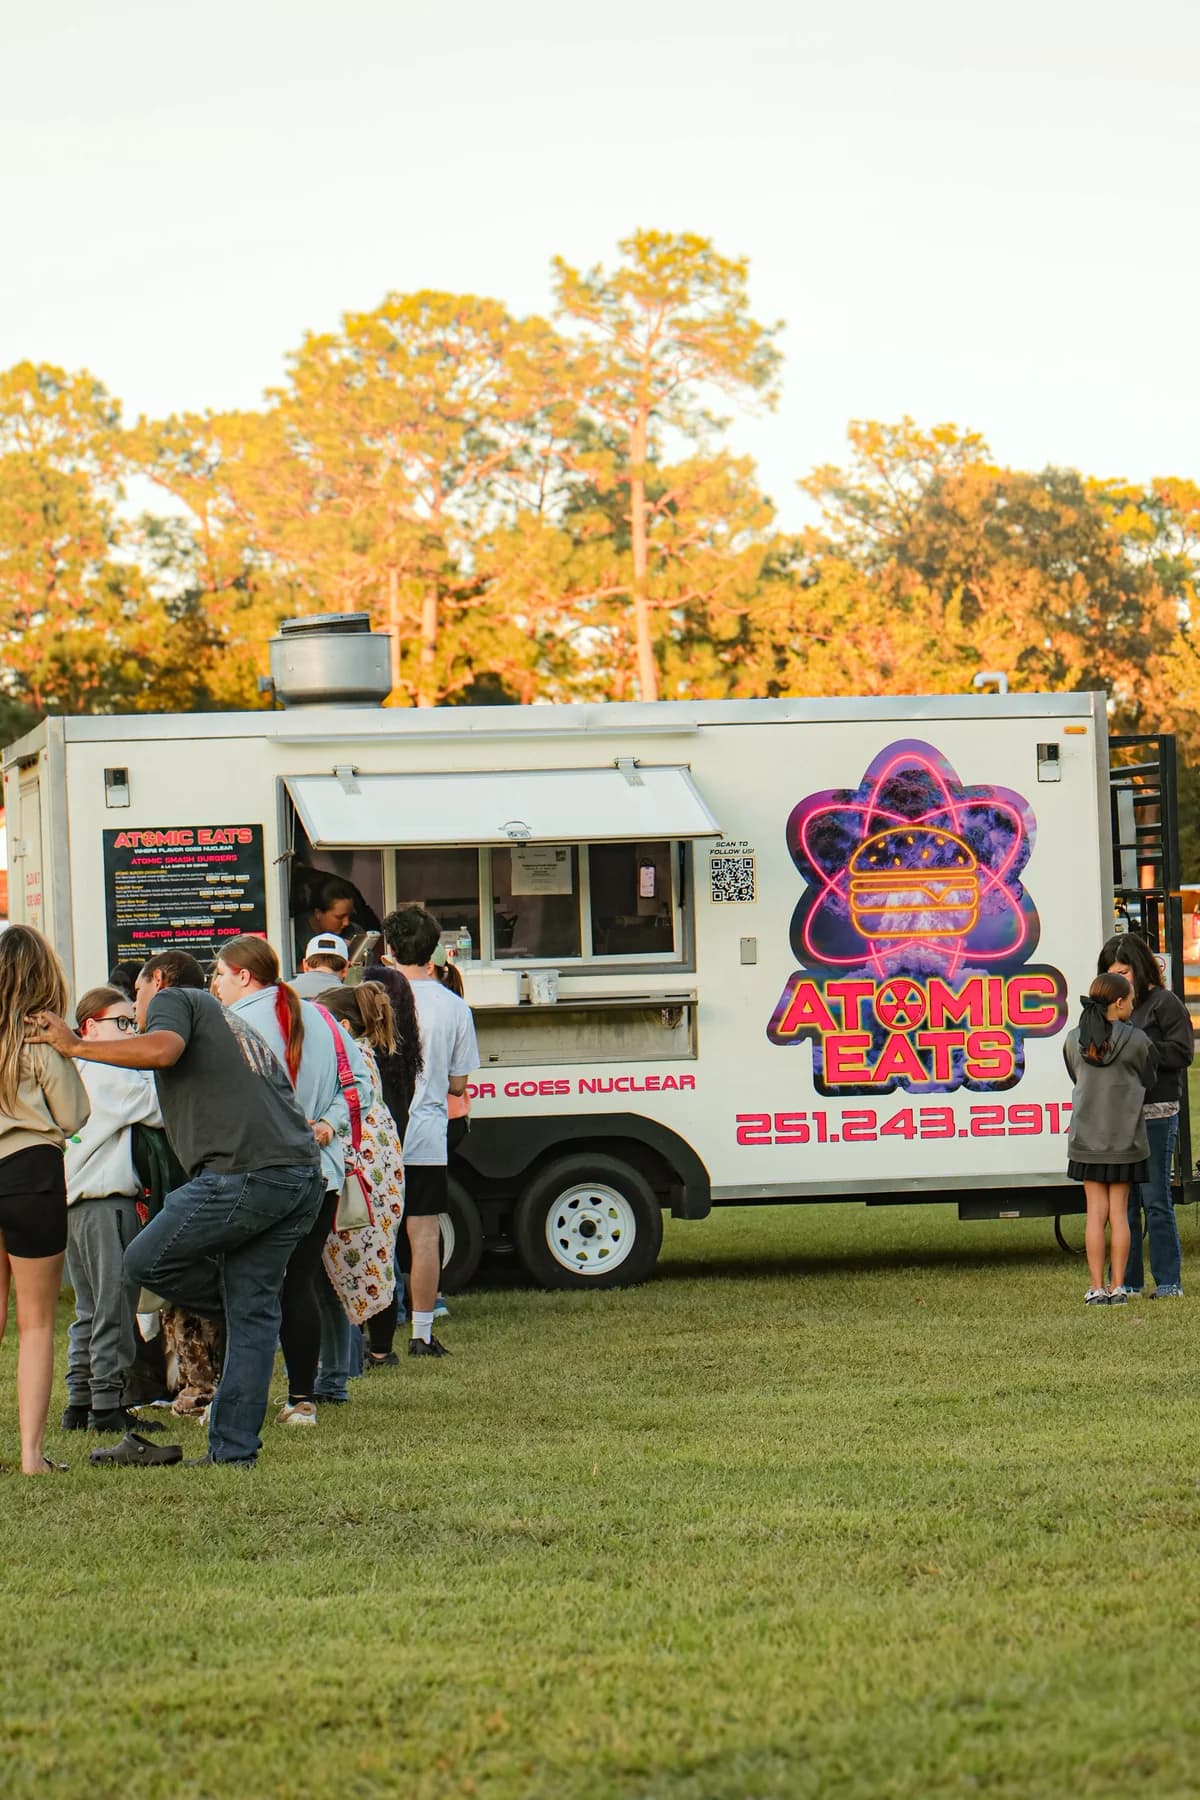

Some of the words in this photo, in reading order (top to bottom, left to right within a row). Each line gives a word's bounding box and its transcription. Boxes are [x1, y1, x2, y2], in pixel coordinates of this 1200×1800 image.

[114, 830, 193, 848] ATOMIC
[198, 828, 252, 845] EATS
[131, 857, 163, 865] ATOMIC
[165, 856, 195, 864] SMASH
[197, 854, 238, 863] BURGERS
[132, 931, 173, 939] REACTOR
[175, 929, 216, 937] SAUSAGE
[780, 976, 1056, 1034] ATOMIC
[825, 1031, 1013, 1084] EATS
[504, 1079, 571, 1097] GOES
[578, 1074, 696, 1095] NUCLEAR
